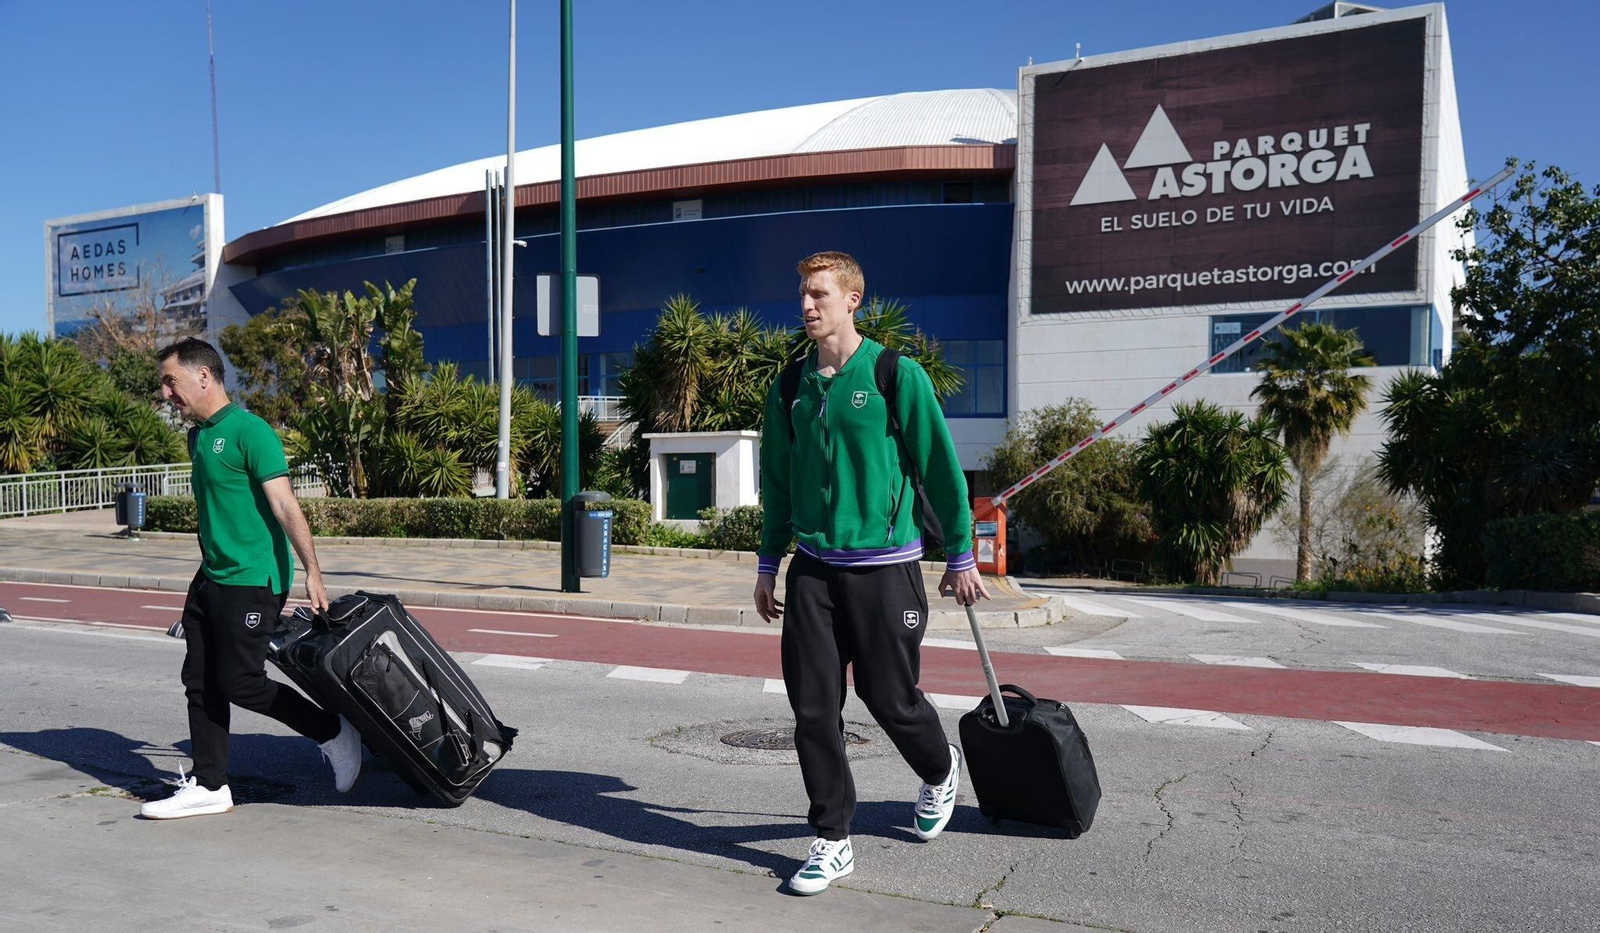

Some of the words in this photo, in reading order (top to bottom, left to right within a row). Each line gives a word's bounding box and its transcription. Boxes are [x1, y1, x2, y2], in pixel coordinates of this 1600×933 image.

[1213, 123, 1370, 160] PARQUET
[1147, 144, 1374, 200] ASTORGA
[1101, 216, 1123, 232] EL
[1130, 209, 1197, 229] SUELO
[1206, 205, 1234, 223] DE
[1242, 202, 1271, 219] TU
[1279, 196, 1334, 216] VIDA
[71, 239, 126, 262] AEDAS
[71, 262, 126, 282] HOMES
